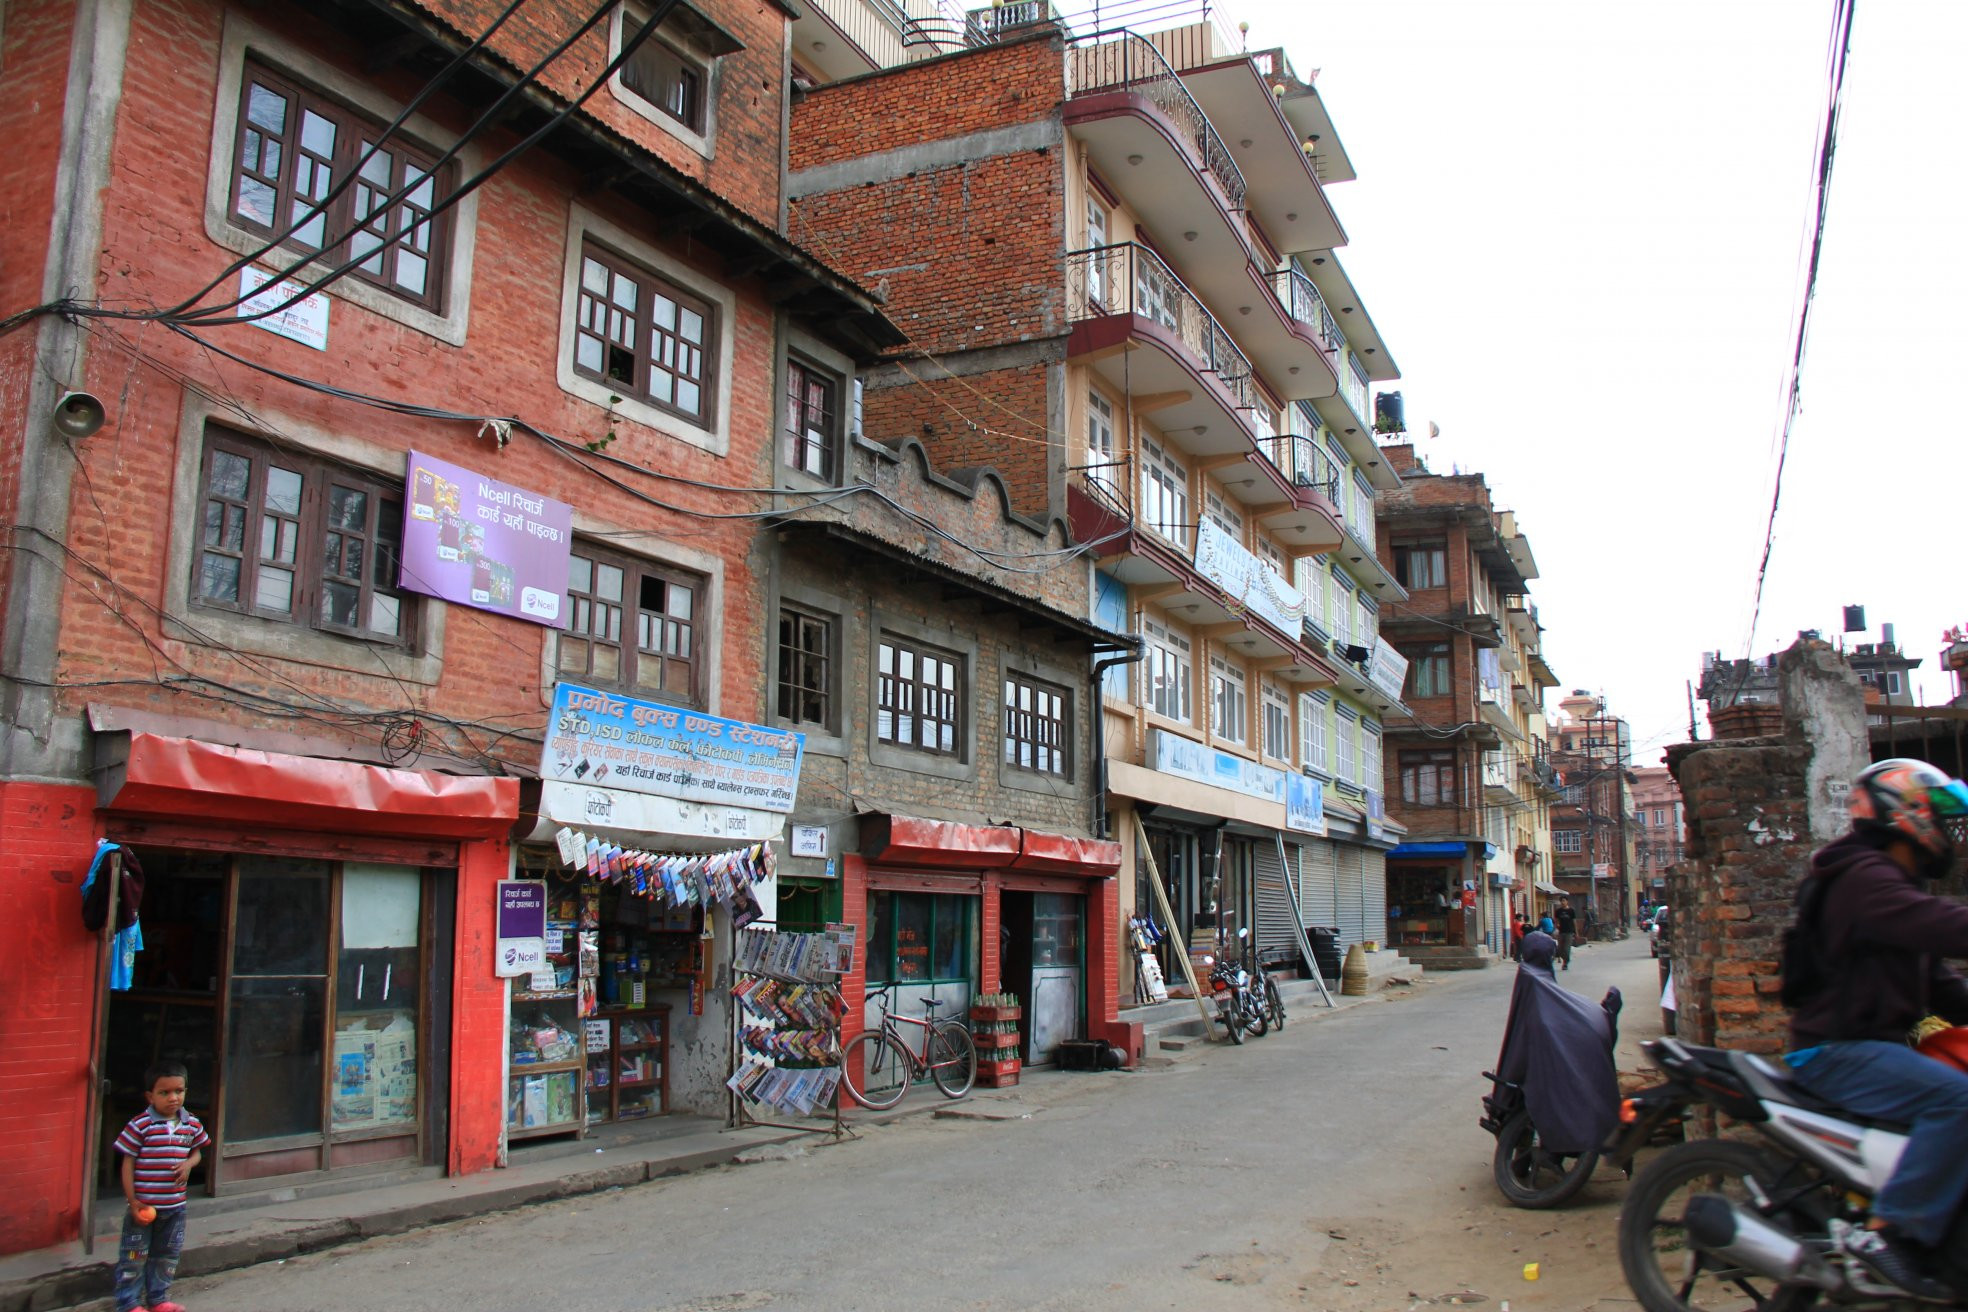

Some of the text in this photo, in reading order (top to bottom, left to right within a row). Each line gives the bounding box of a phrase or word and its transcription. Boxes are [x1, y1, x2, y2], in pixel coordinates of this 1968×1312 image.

[479, 482, 544, 516] Ncell रिचार्ज
[477, 504, 502, 523] कार्ड
[537, 599, 555, 611] Ncell
[568, 690, 628, 719] प्रमोद
[632, 704, 681, 729] बुक्स
[684, 715, 726, 738] एण्ड
[558, 716, 622, 740] STD,ISD
[518, 952, 539, 962] Ncell
